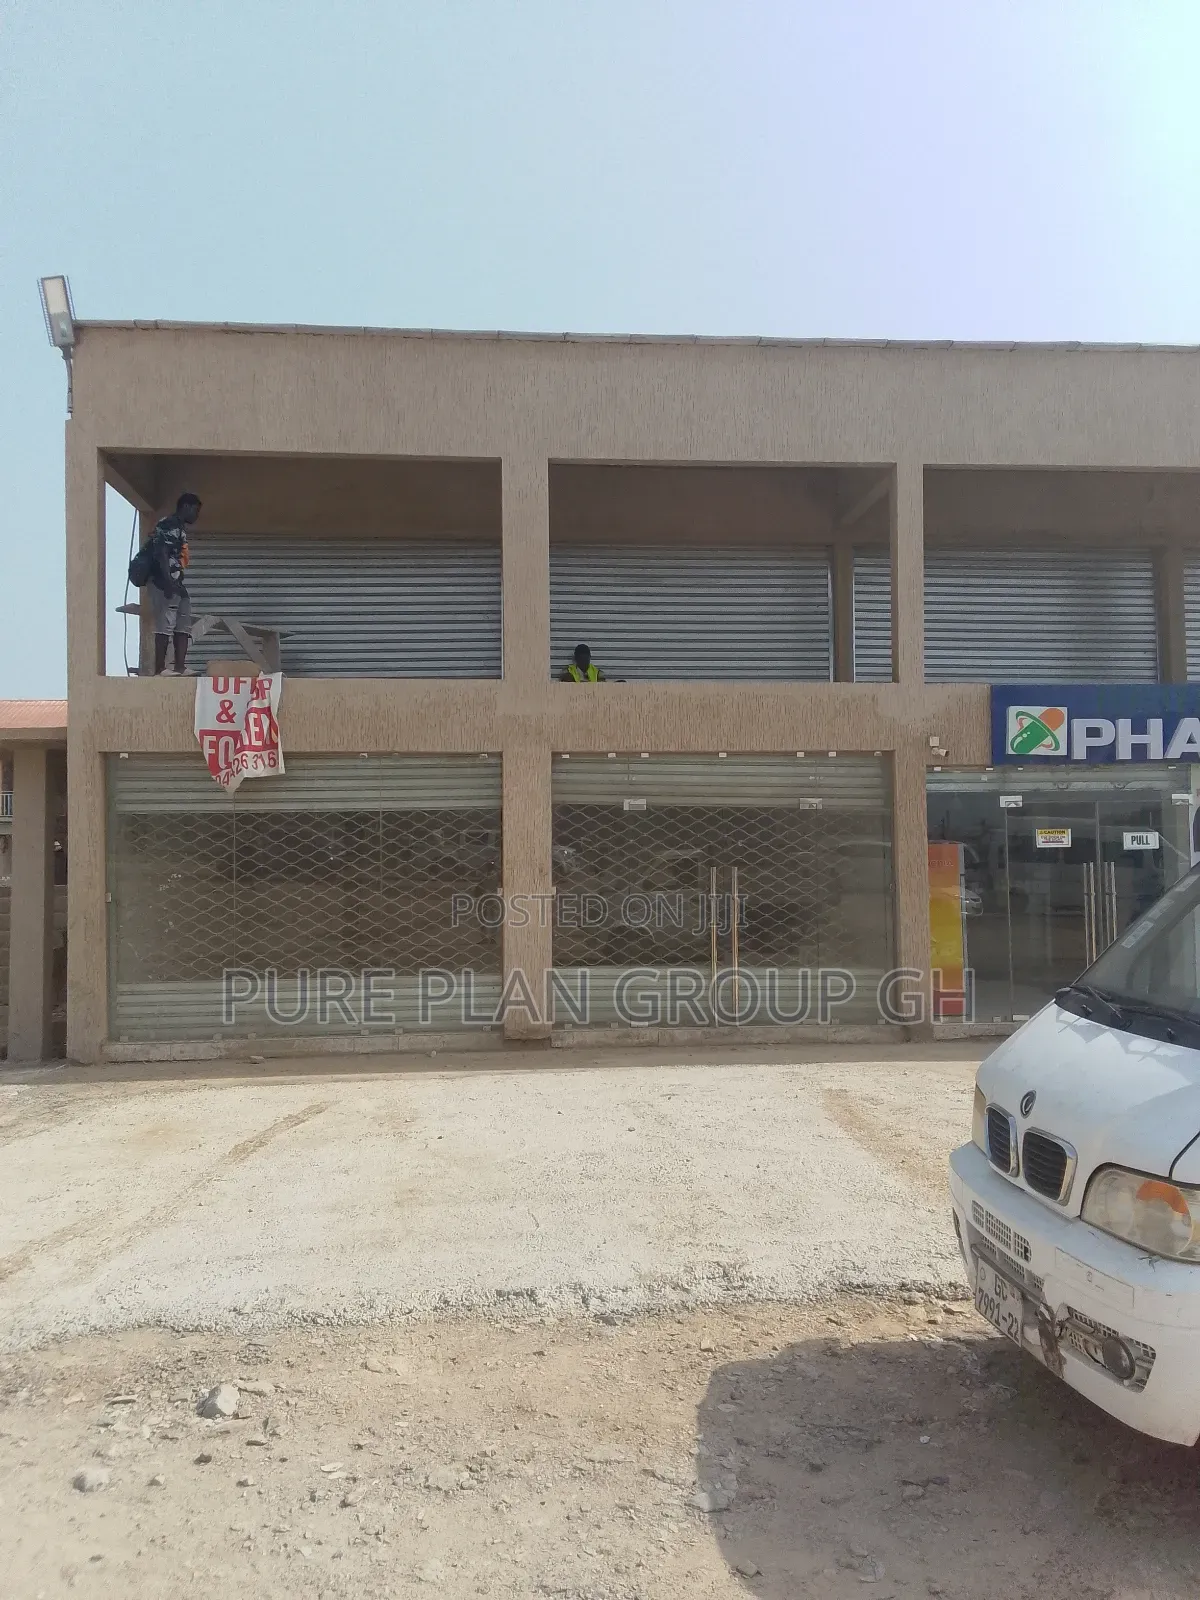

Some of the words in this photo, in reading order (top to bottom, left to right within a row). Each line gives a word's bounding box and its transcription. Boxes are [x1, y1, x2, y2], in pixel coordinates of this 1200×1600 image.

[216, 699, 237, 724] &
[1071, 717, 1200, 760] PHA
[1130, 834, 1150, 846] PULL
[978, 1286, 1020, 1345] 7991-22
